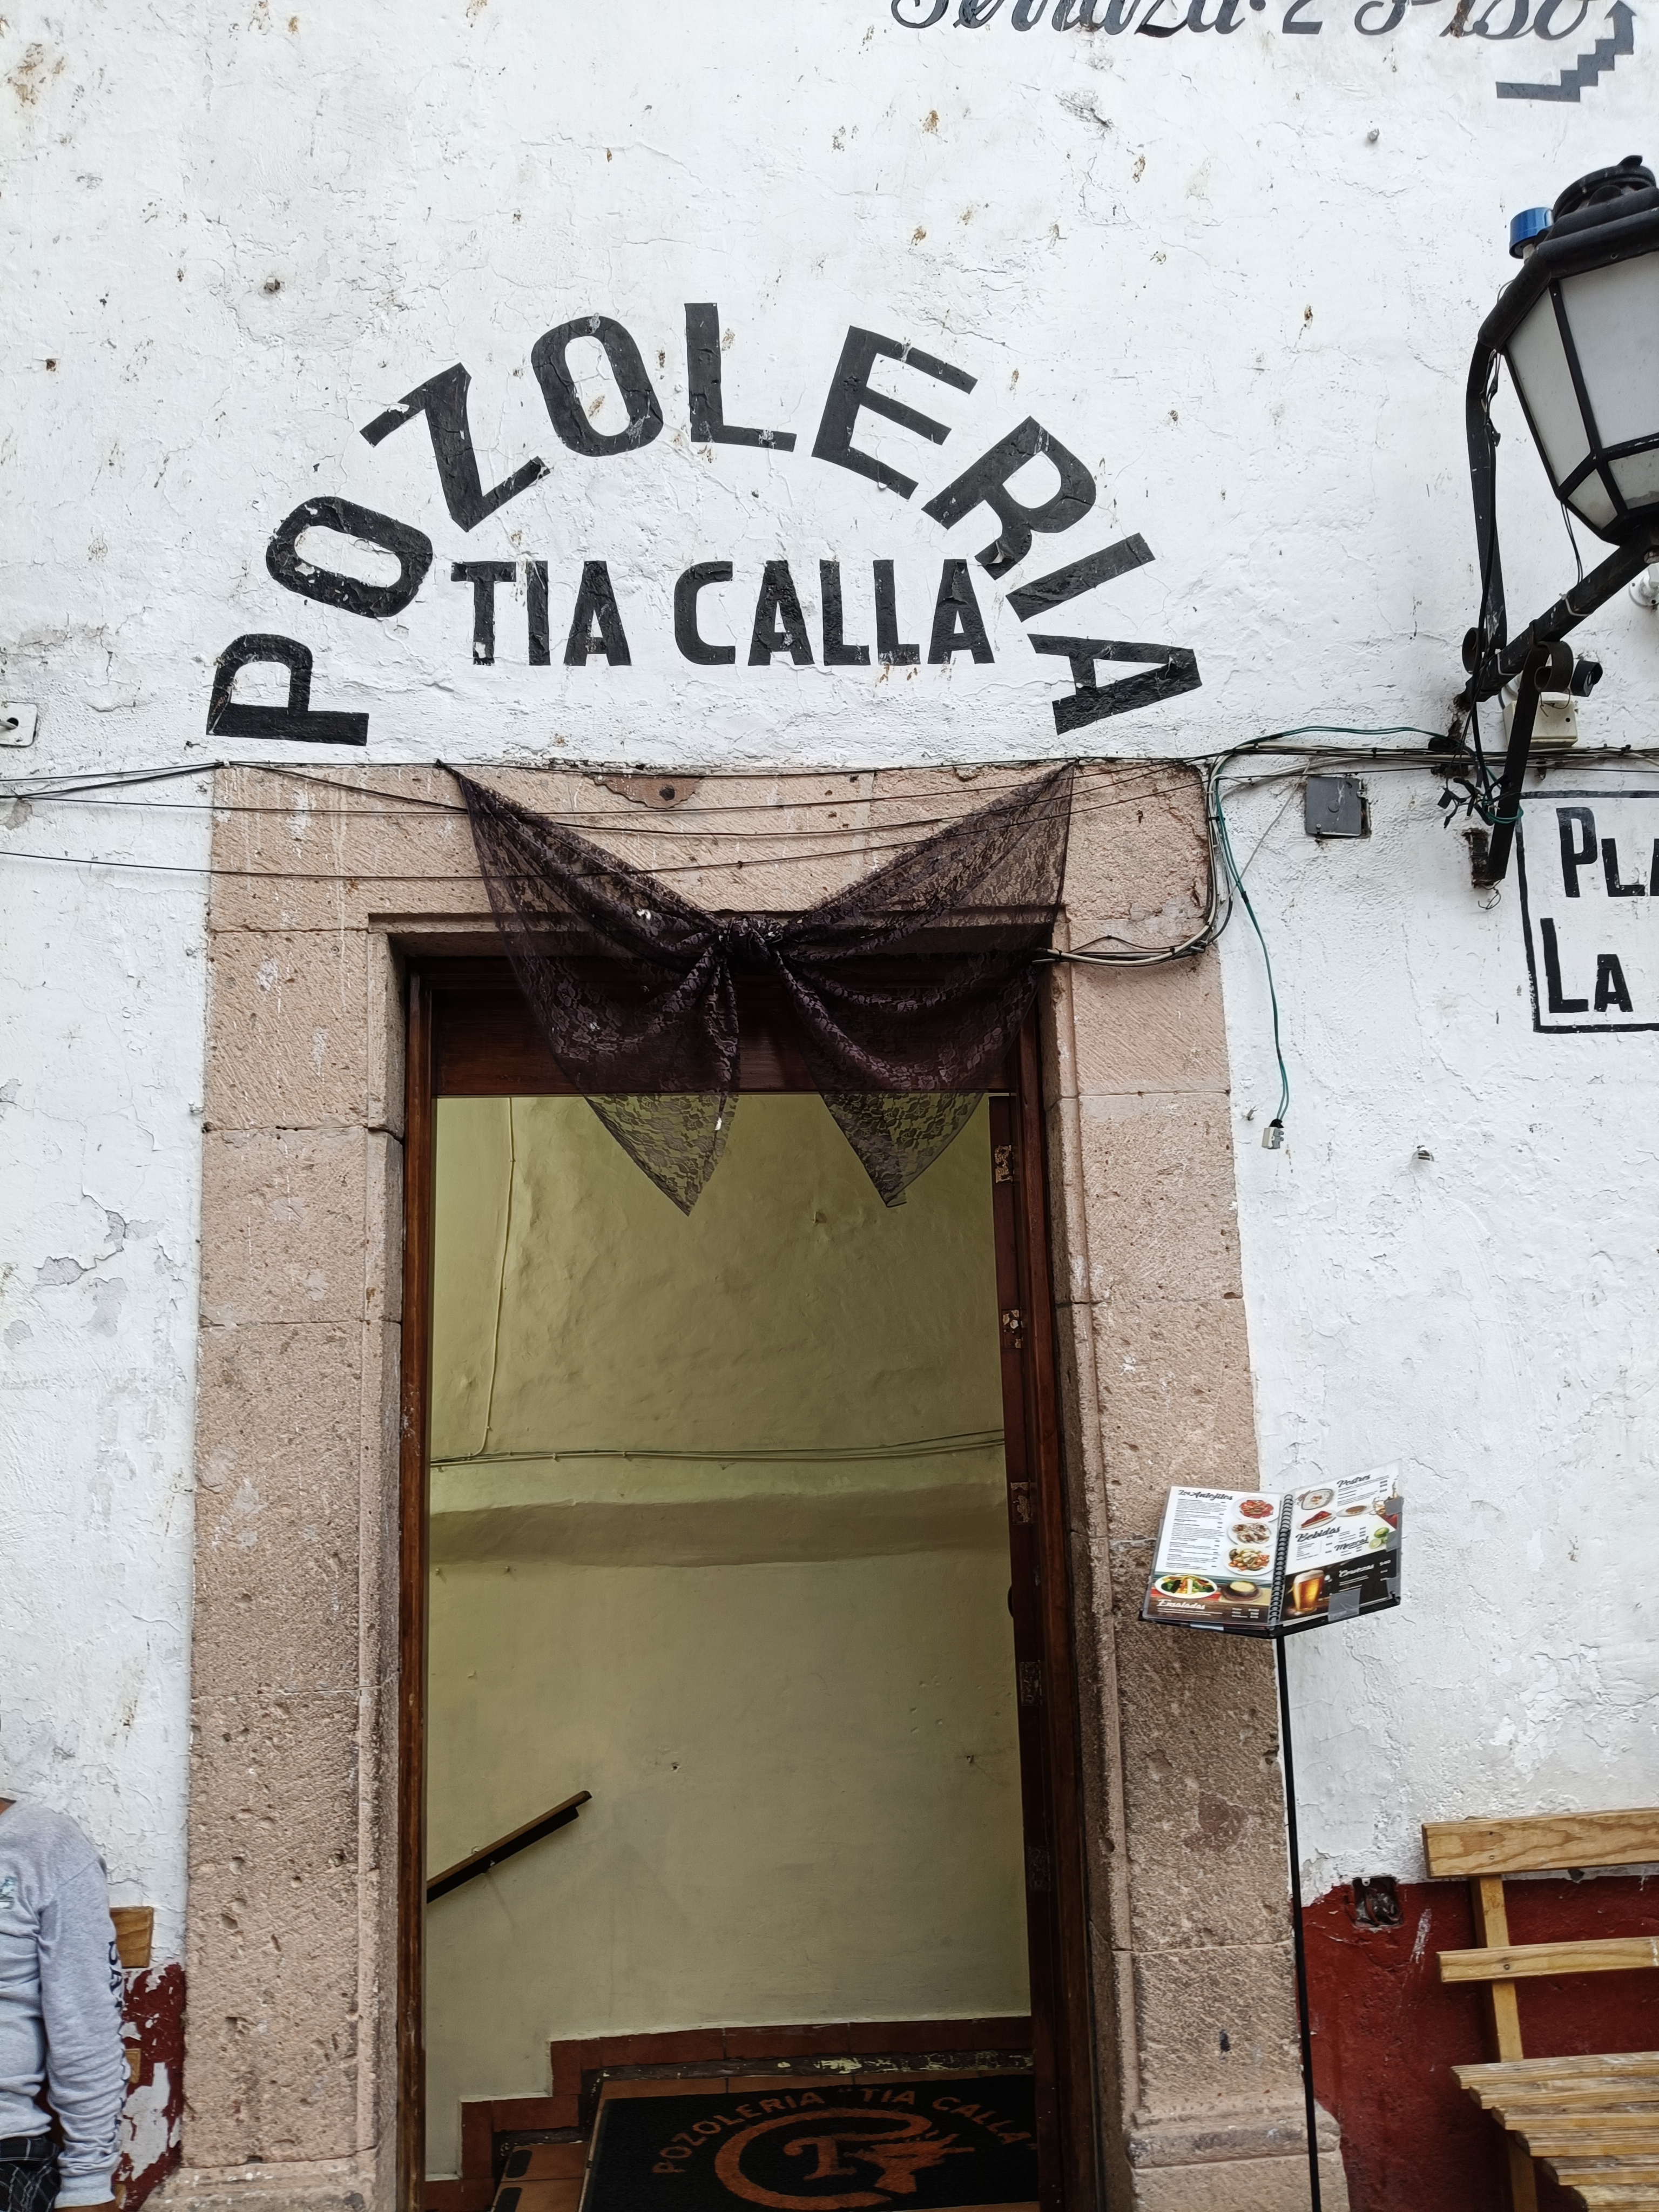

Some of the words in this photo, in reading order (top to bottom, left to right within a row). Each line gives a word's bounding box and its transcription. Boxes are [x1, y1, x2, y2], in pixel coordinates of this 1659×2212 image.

[206, 302, 1203, 746] POZOLERIA
[450, 558, 632, 667] TIA
[673, 558, 995, 667] CALLA
[1555, 806, 1659, 898] PL
[1540, 918, 1634, 1014] LA
[651, 2091, 826, 2174] POZOLERIA
